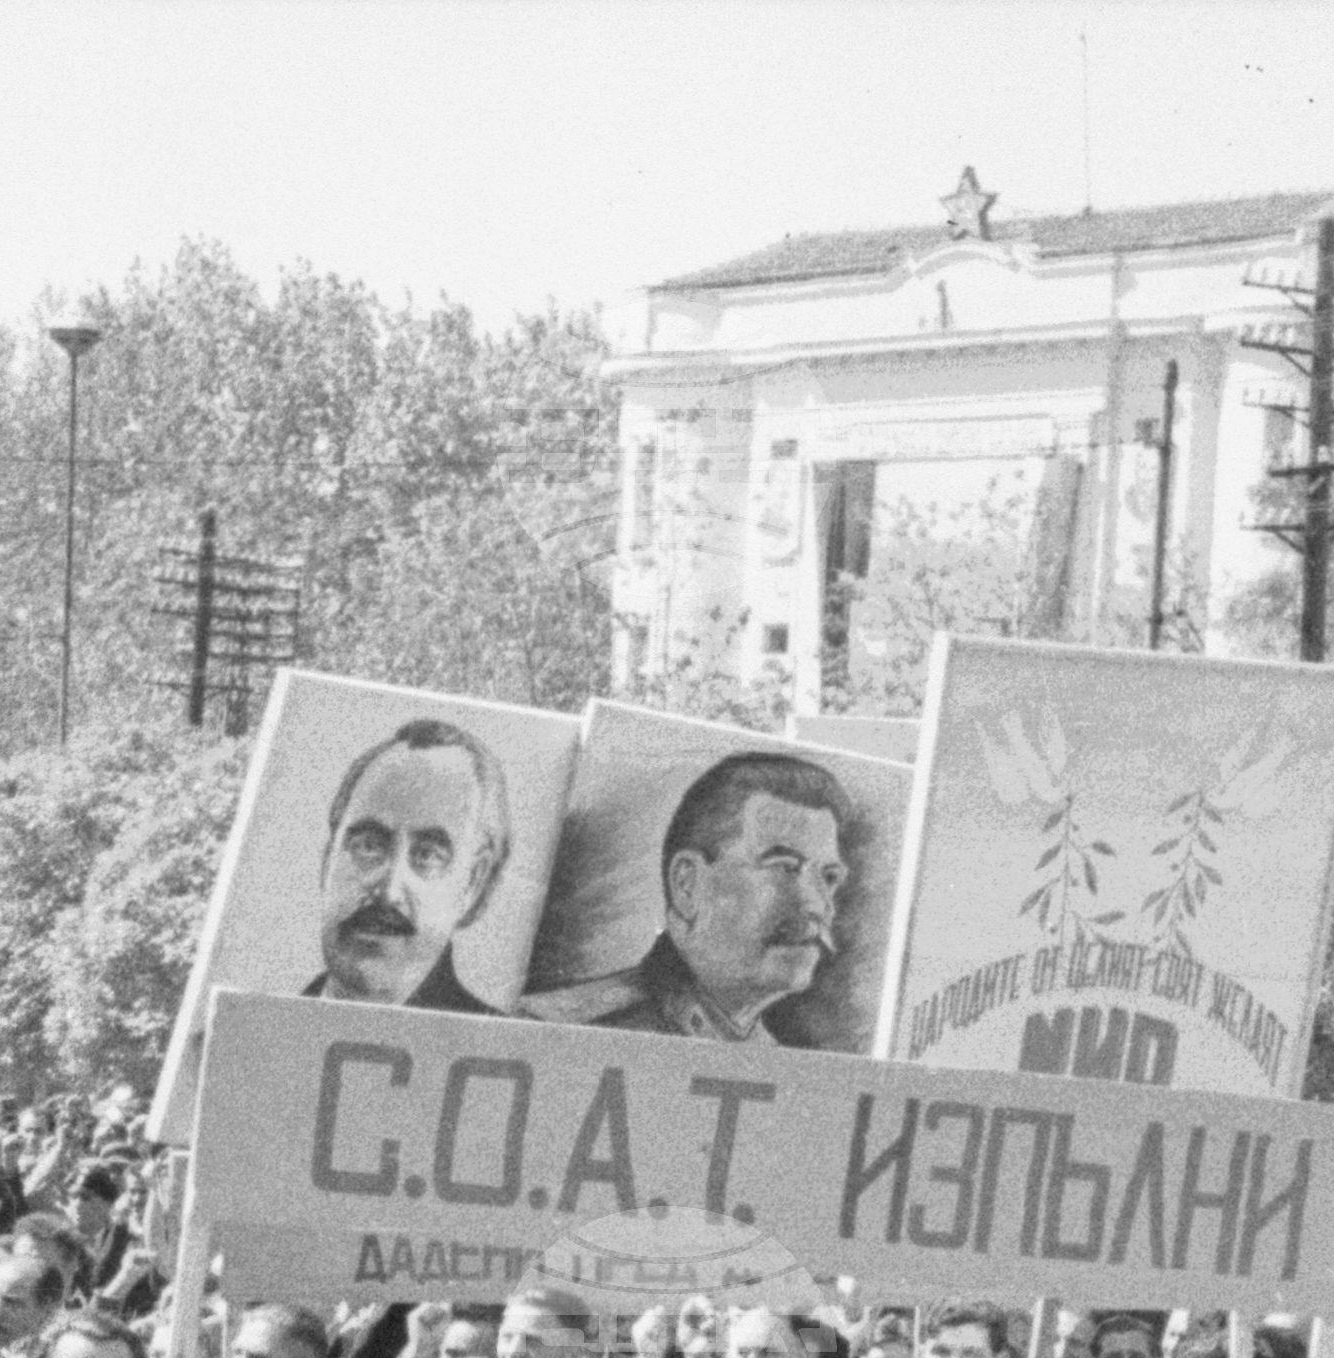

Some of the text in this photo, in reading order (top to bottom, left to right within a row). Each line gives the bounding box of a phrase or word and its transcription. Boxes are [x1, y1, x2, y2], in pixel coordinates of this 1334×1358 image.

[1017, 1004, 1179, 1086] МИР
[311, 1041, 777, 1226] С.О.А.Т.
[838, 1093, 1314, 1282] ИЗПЪЛНИ
